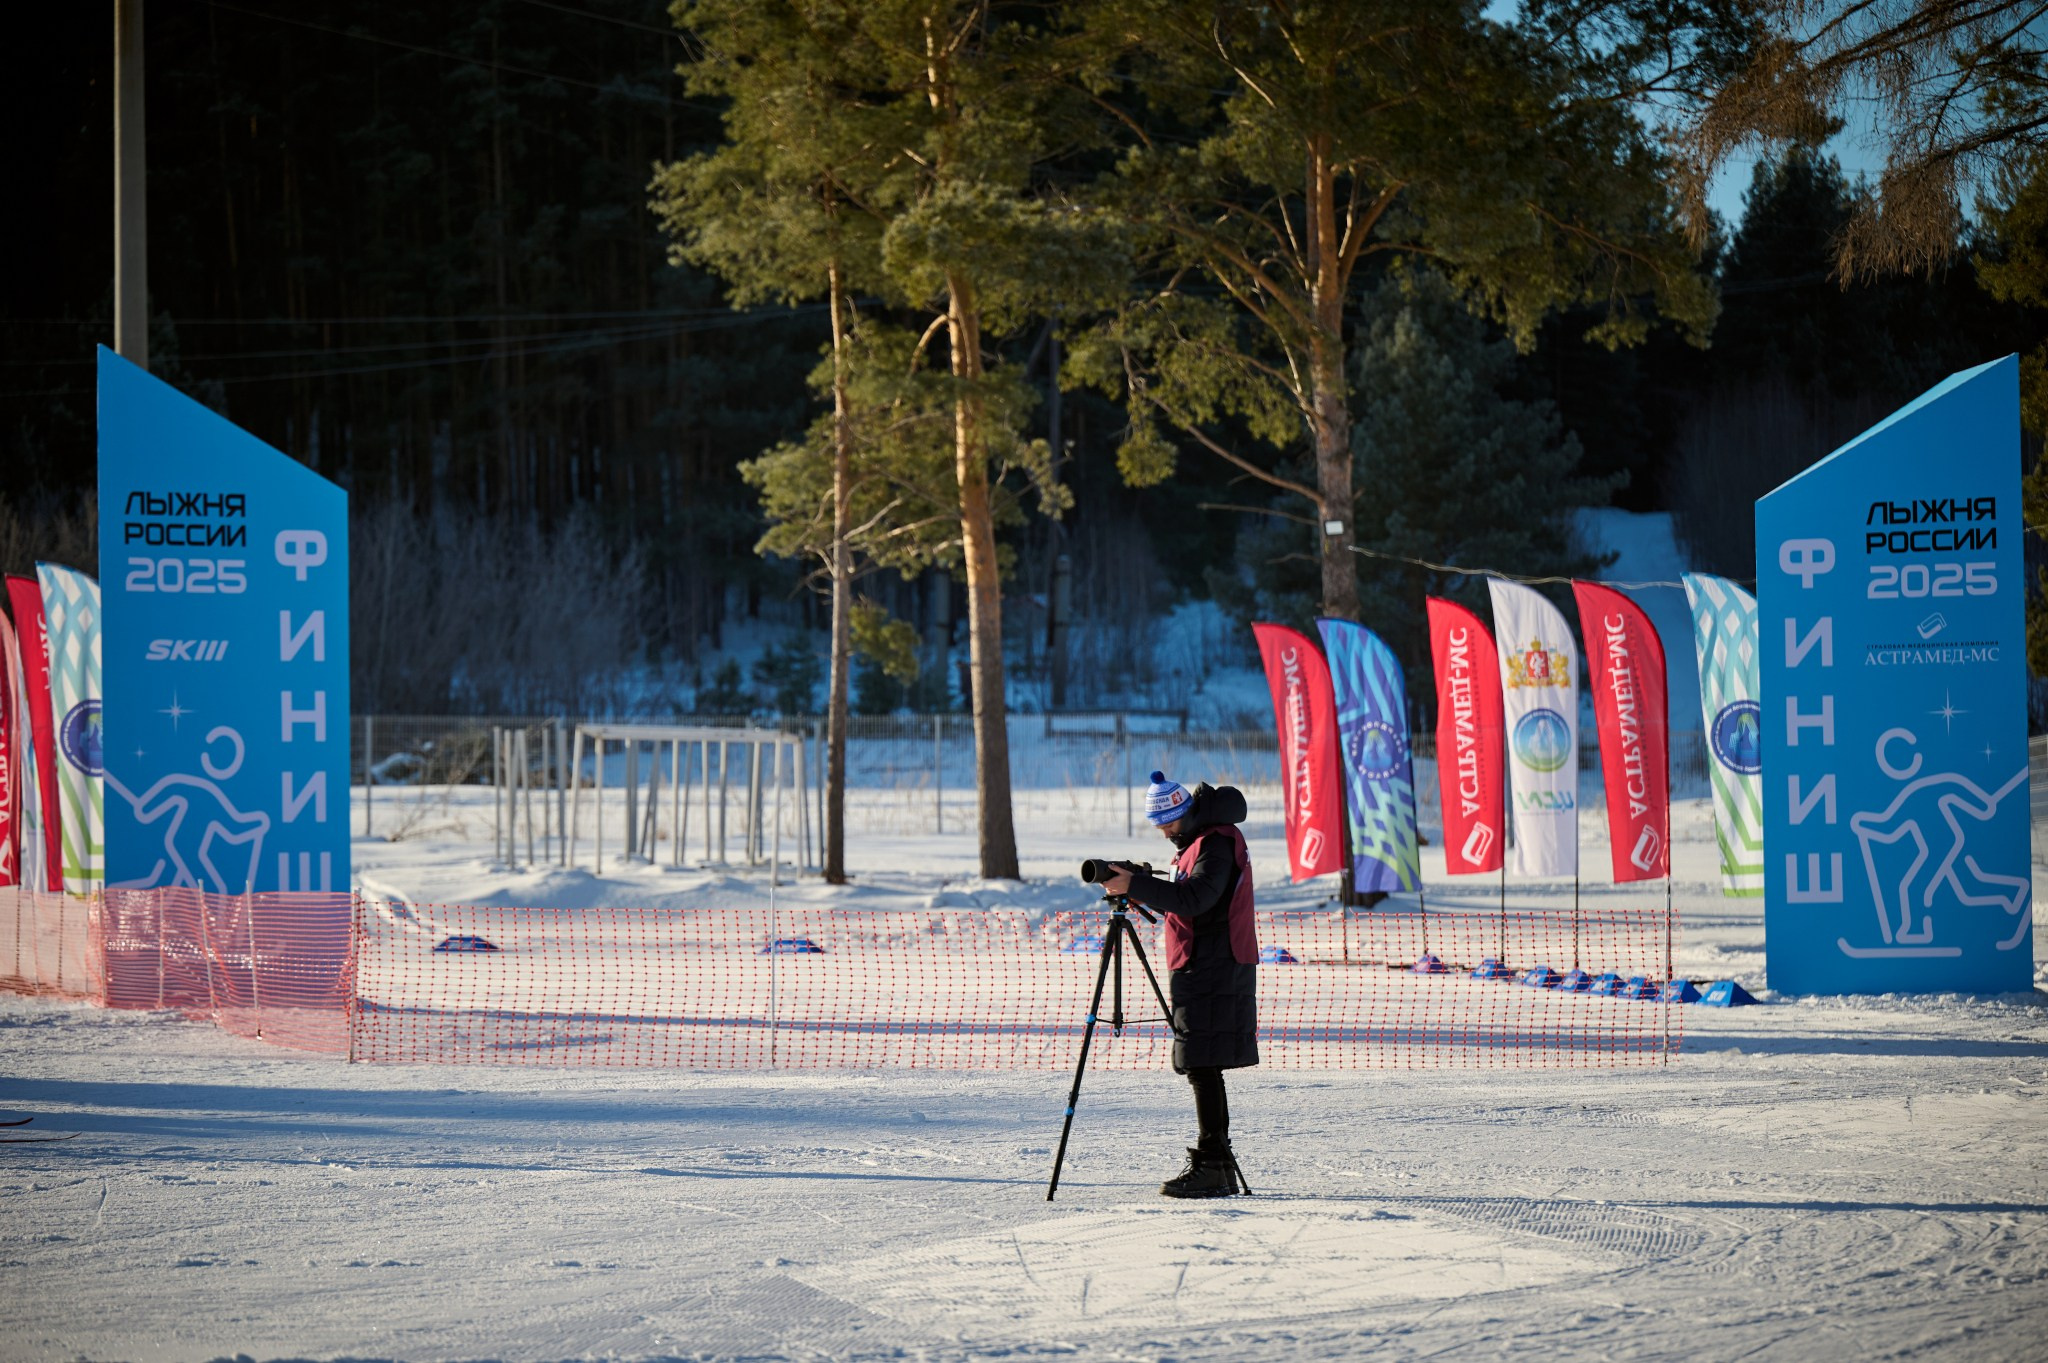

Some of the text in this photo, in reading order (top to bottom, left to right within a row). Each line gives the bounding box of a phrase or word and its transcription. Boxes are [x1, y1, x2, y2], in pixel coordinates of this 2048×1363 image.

[124, 491, 246, 518] ЛЫЖНЯ
[1866, 496, 1996, 525] ЛЫЖНЯ
[124, 522, 247, 547] РОССИИ
[1866, 527, 1997, 554] РОССИИ
[125, 557, 247, 594] 2025
[1867, 561, 1998, 600] 2025
[1865, 647, 2000, 666] АСТРАМЕД-МС
[1778, 537, 1844, 904] ФИНИШ
